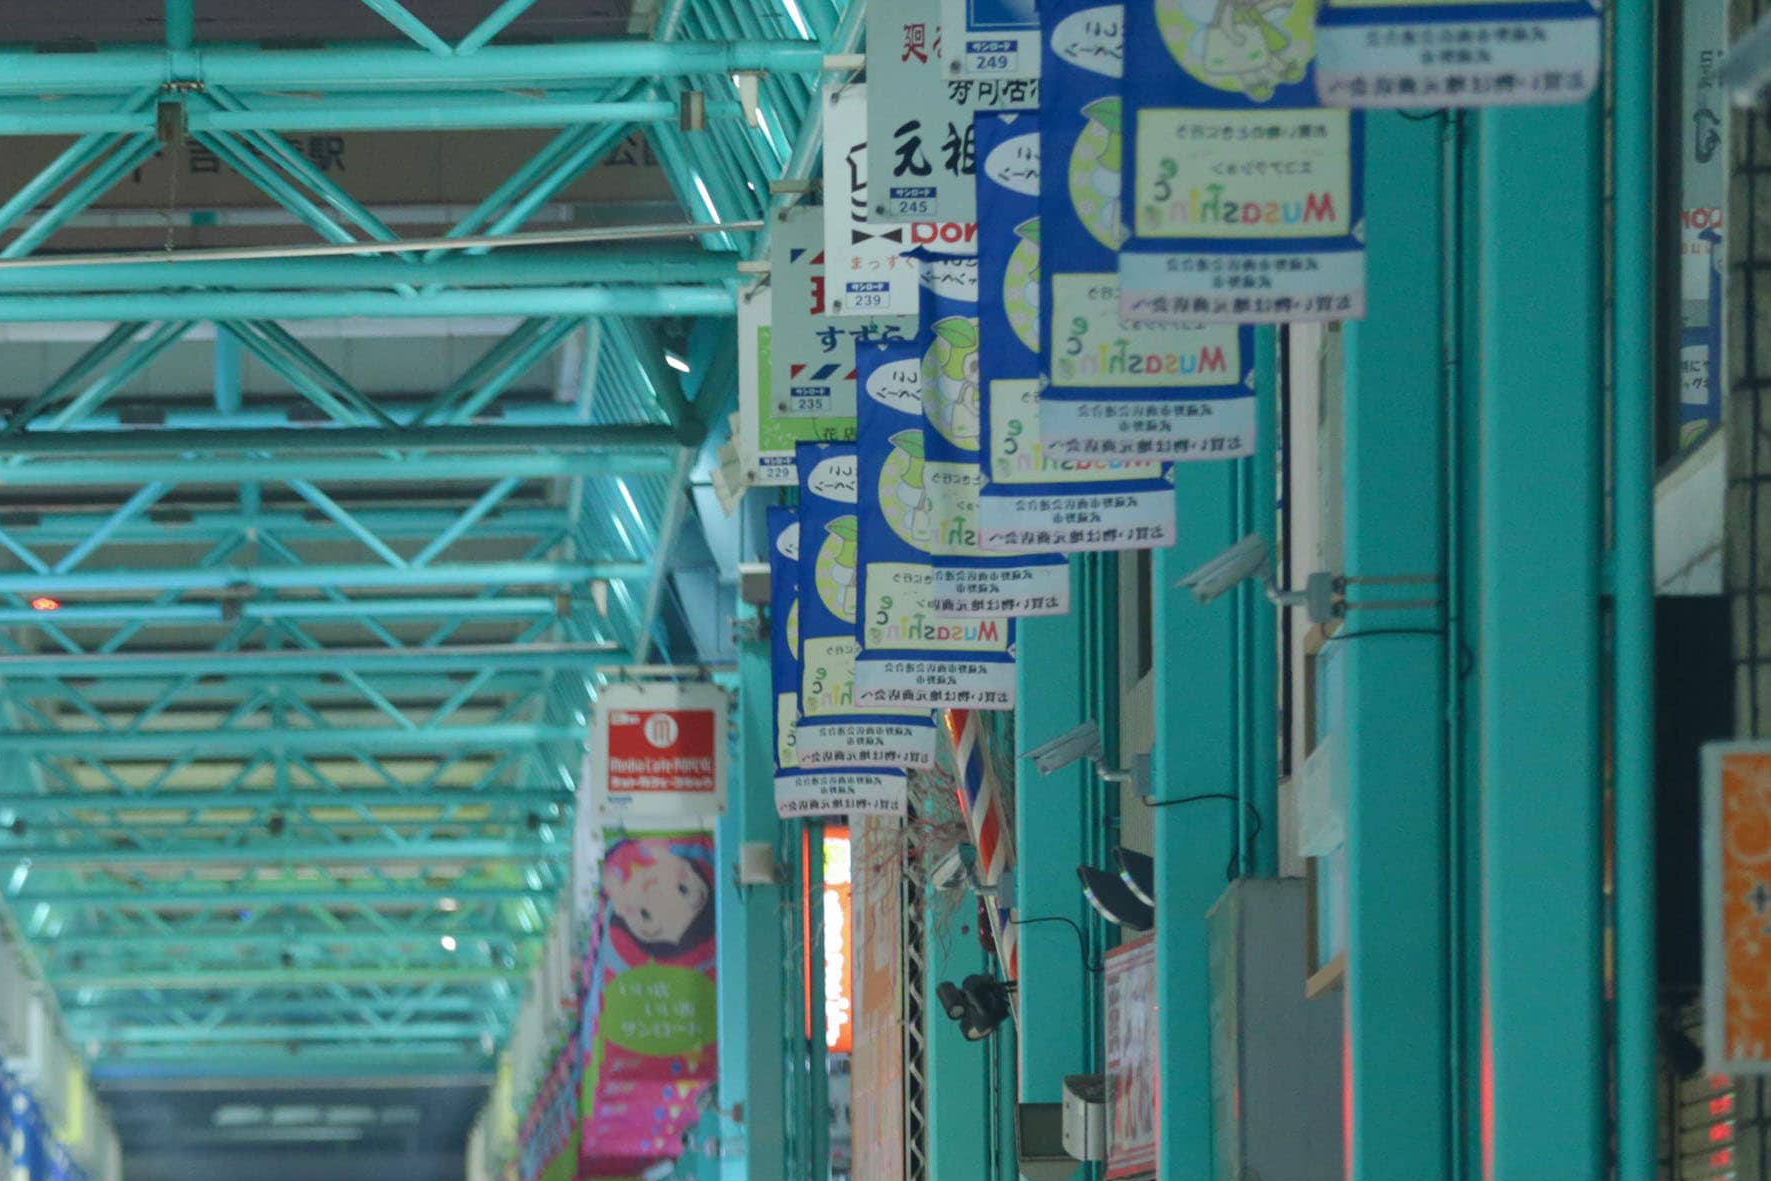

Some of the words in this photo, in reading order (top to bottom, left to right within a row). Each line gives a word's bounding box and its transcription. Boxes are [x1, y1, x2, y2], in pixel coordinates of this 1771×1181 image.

[977, 56, 1008, 69] 249
[900, 201, 927, 213] 245
[855, 295, 881, 306] 239
[799, 399, 822, 409] 235
